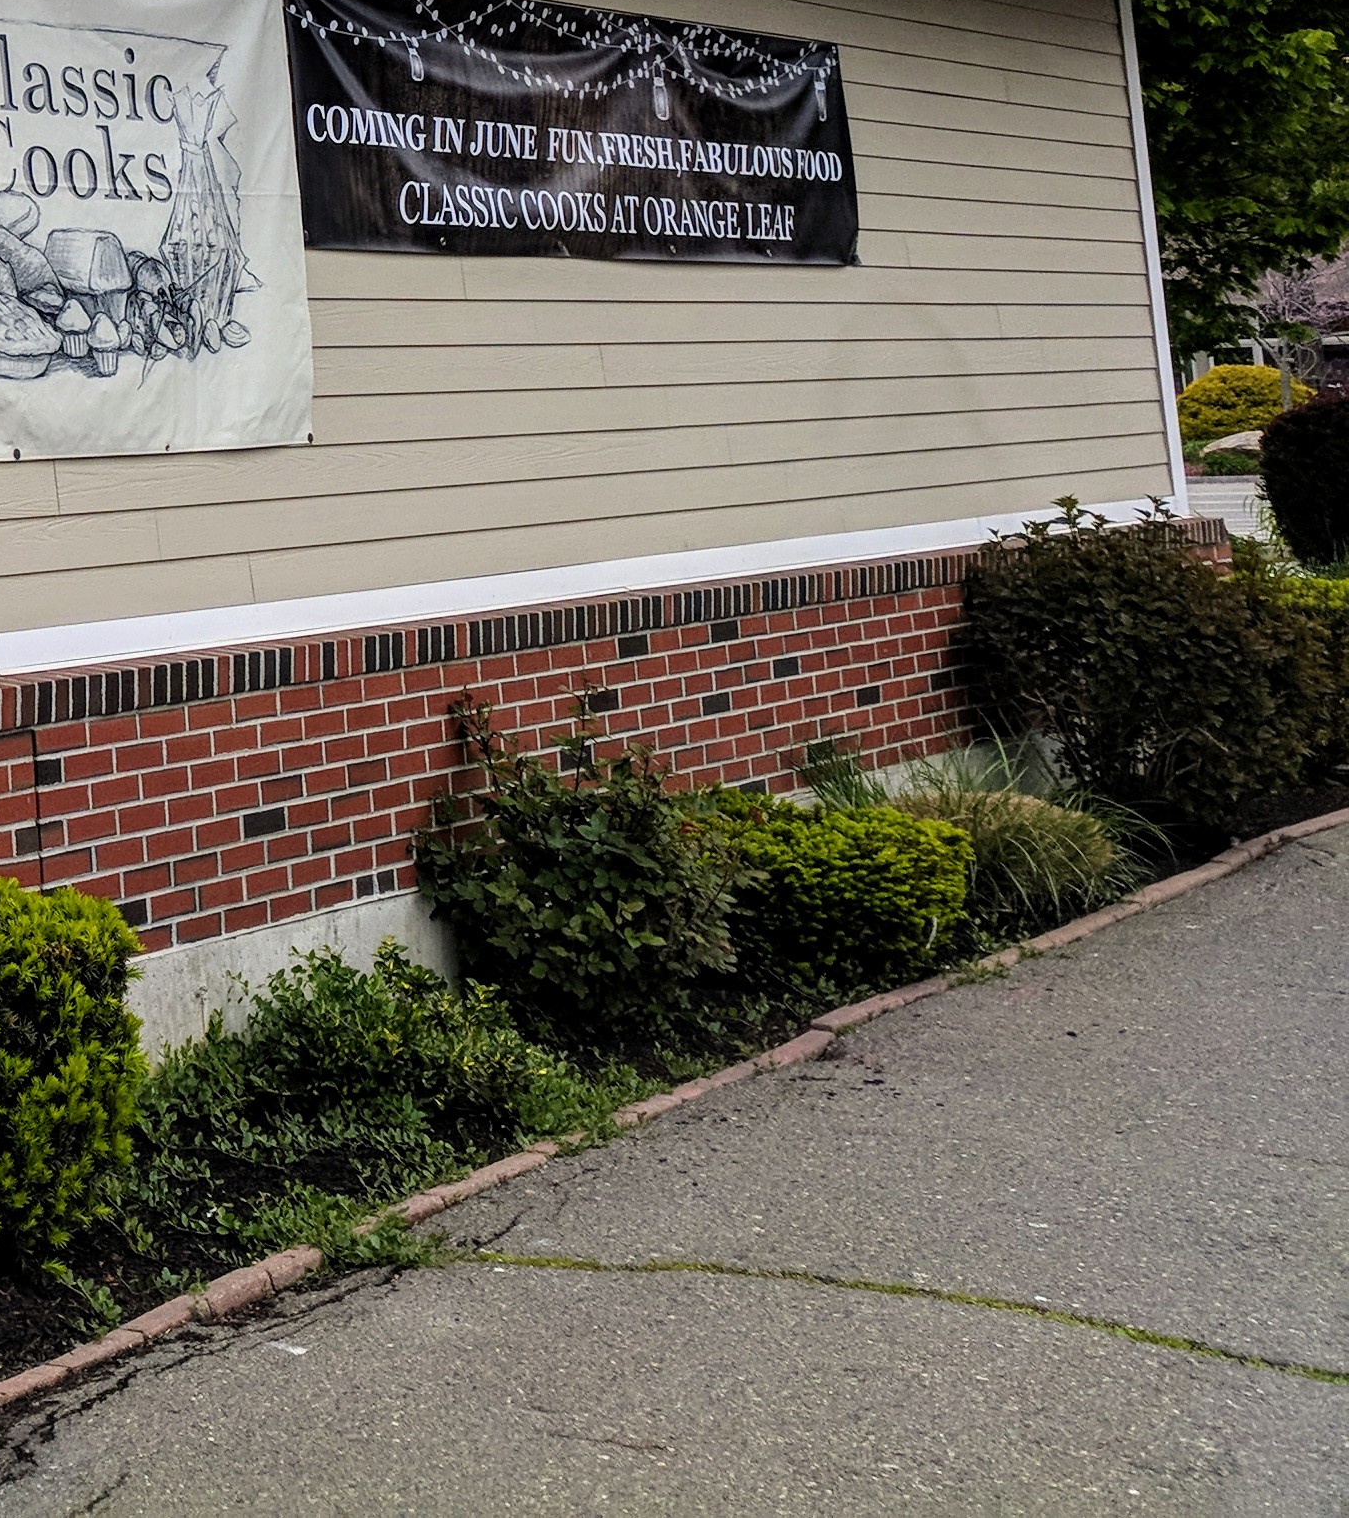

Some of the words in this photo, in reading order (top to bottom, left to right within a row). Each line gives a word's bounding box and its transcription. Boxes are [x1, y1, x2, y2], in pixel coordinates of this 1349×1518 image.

[307, 103, 427, 153] COMING
[433, 116, 466, 154] IN
[470, 120, 538, 160] JUNE
[795, 148, 843, 182] FOOD
[399, 180, 518, 230] CLASSIC
[519, 188, 607, 234] COOKS
[610, 194, 640, 234] AT
[643, 196, 741, 240] ORANGE
[744, 201, 796, 241] LEAF
